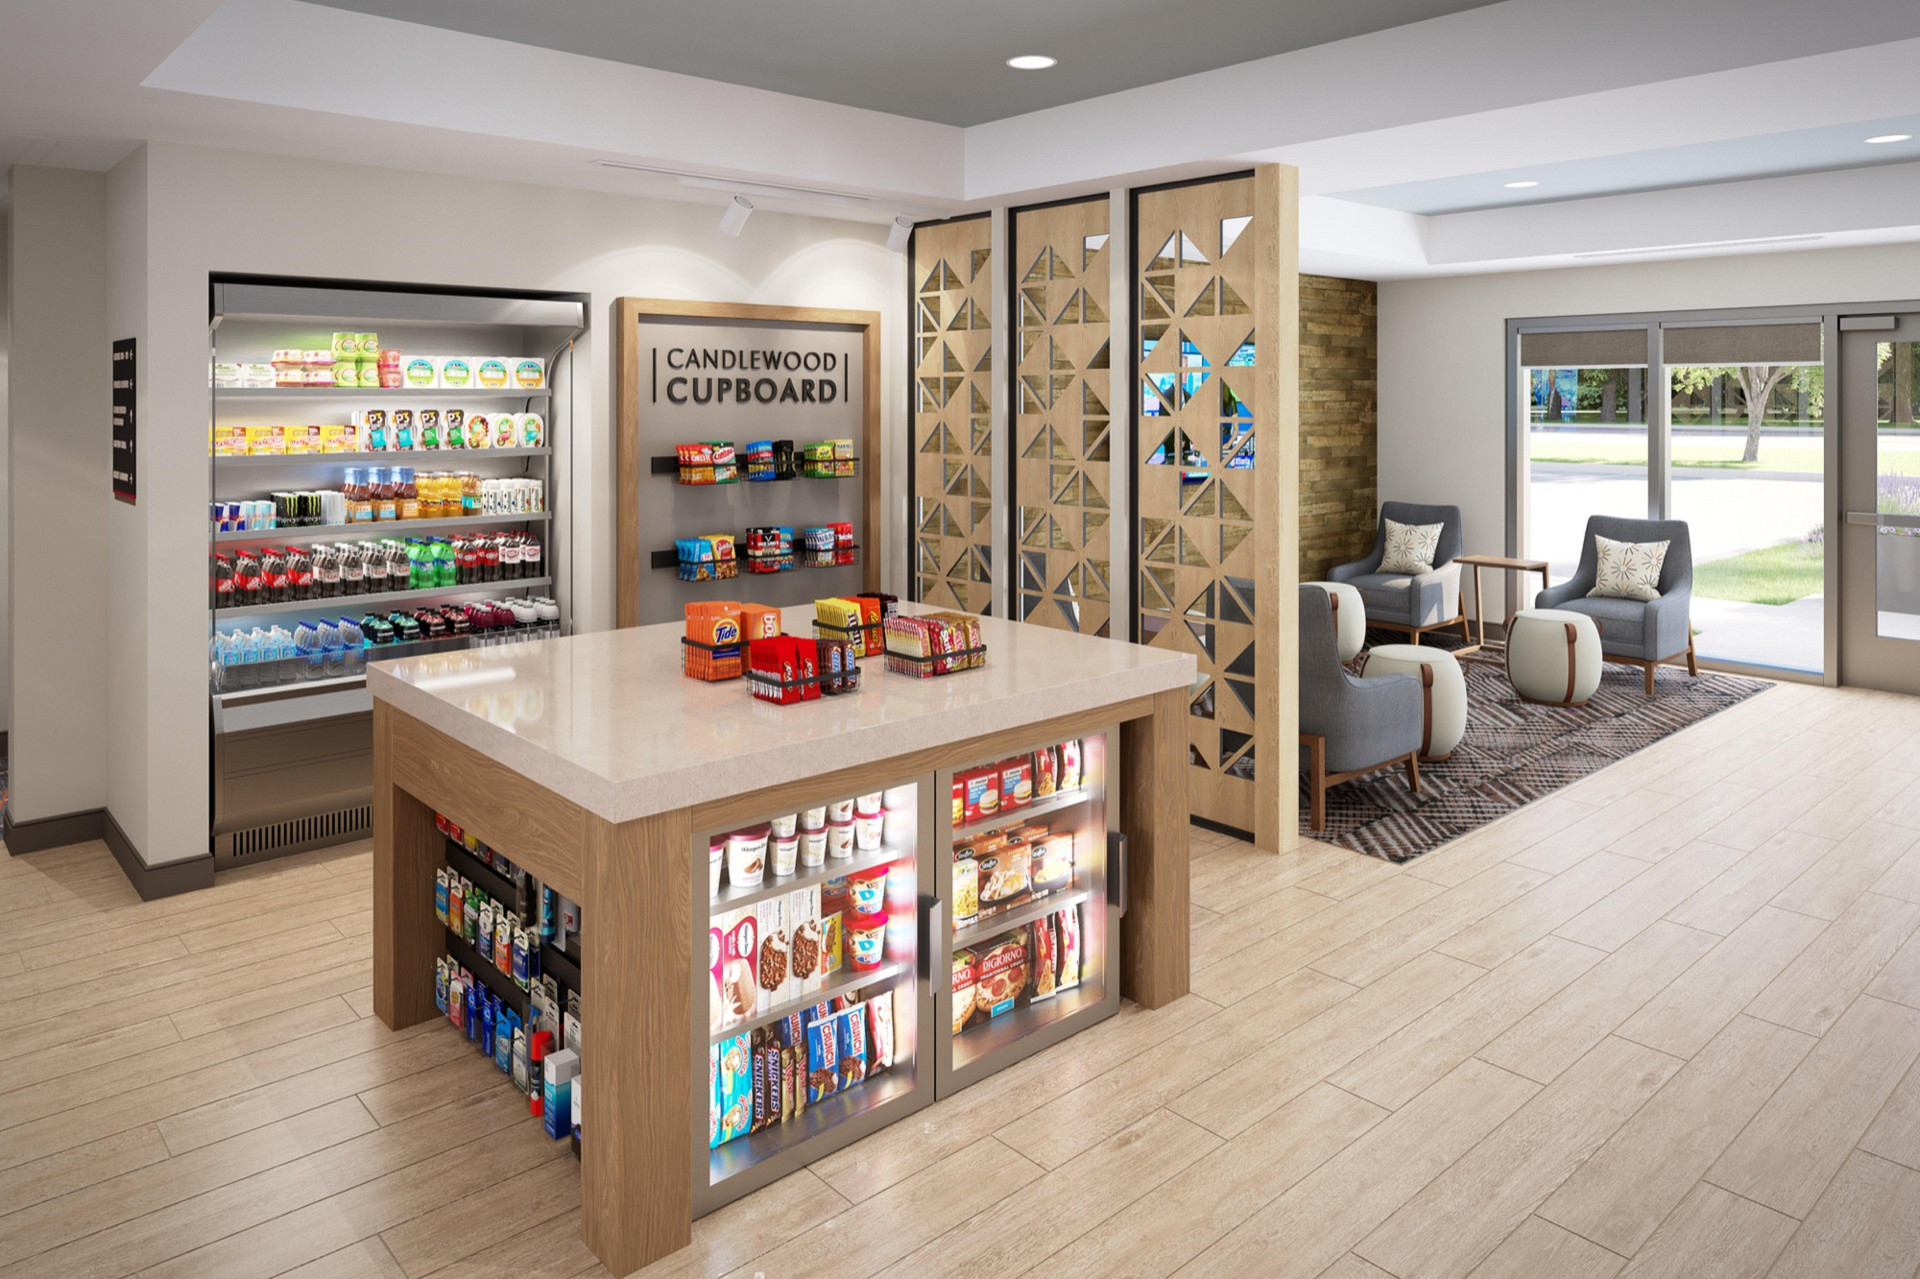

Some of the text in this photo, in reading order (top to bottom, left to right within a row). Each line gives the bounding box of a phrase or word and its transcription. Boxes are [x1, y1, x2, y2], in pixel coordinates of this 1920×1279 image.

[667, 348, 837, 371] CANDLEWOOD
[667, 377, 837, 404] CUPBOARD
[369, 411, 383, 425] P3
[396, 411, 410, 425] P3
[421, 411, 436, 425] P3
[447, 411, 461, 425] P3
[716, 626, 737, 643] Tide
[980, 966, 1010, 980] TRADITIONAL
[1010, 959, 1024, 969] CRUST
[982, 948, 1023, 973] DIGIORNO
[790, 1012, 802, 1046] RUNCH
[850, 1013, 863, 1055] CRUNCH
[822, 1024, 835, 1067] CRUNCH
[755, 1056, 764, 1119] SNICKERS
[771, 1049, 779, 1112] SNICKERS
